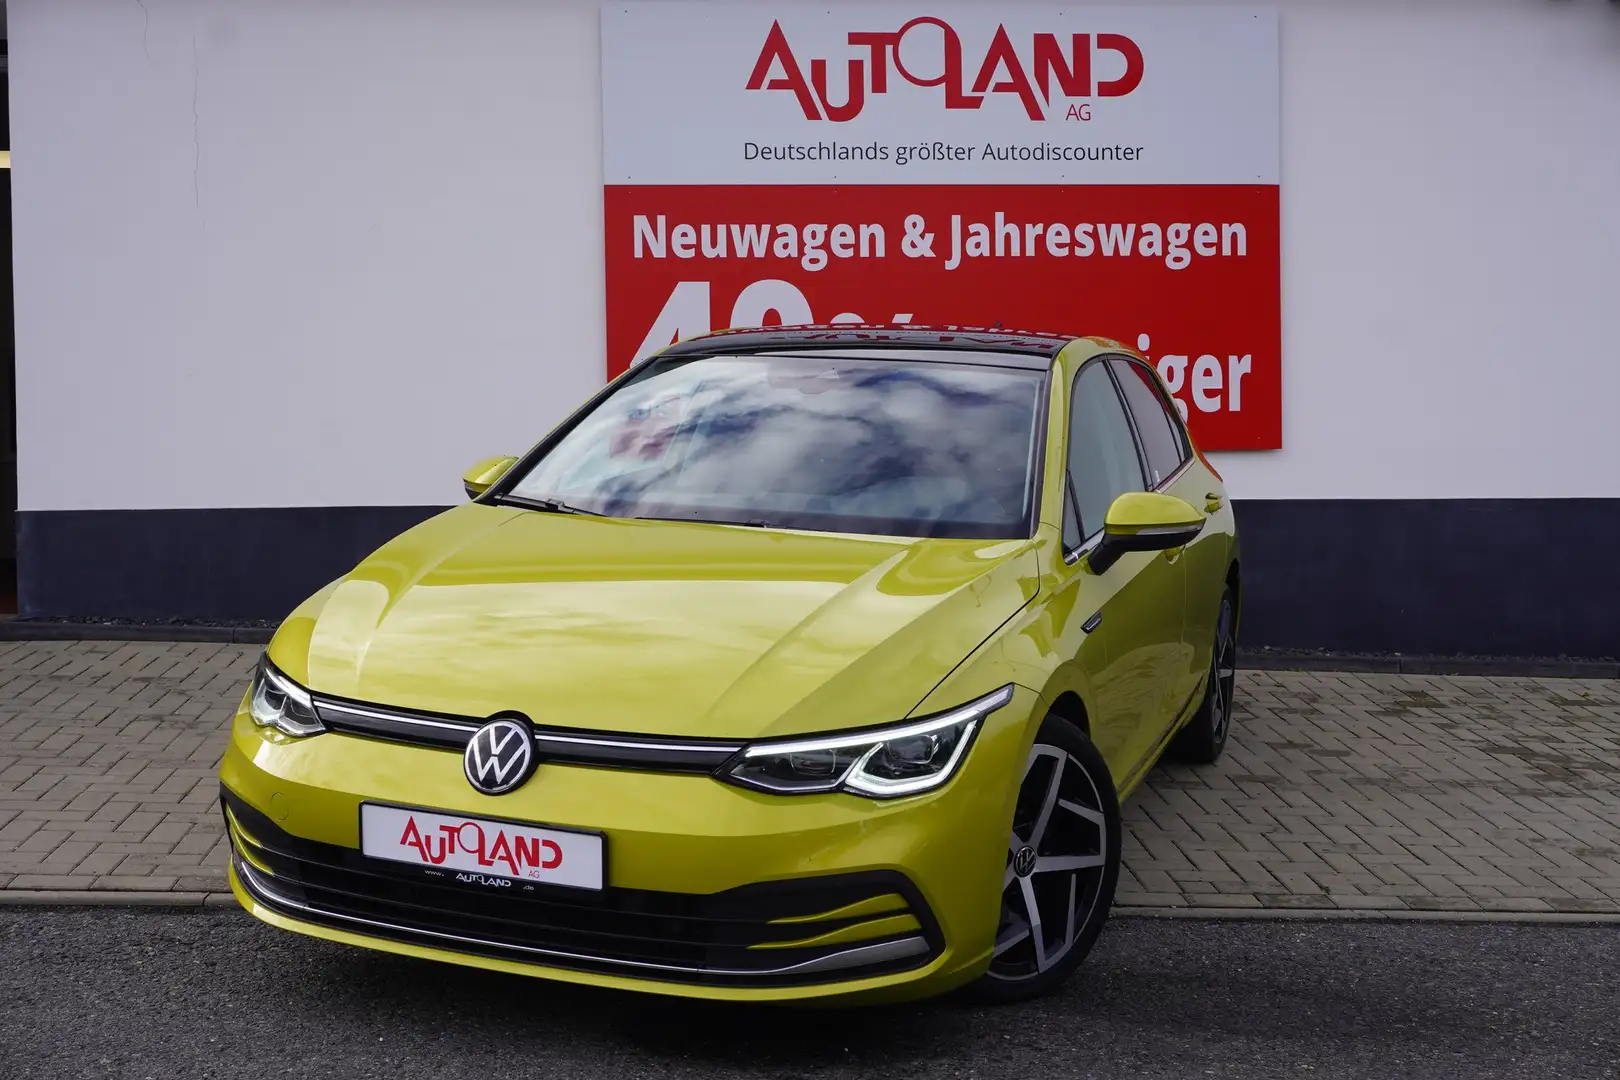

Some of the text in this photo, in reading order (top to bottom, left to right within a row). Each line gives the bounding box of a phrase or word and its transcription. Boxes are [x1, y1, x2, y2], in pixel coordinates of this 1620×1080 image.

[1066, 103, 1091, 121] AG
[744, 142, 1144, 165] Deutschlands größter Autodiscounter
[633, 212, 1247, 271] Neuwagen & Jahreswagen
[528, 869, 540, 879] AG
